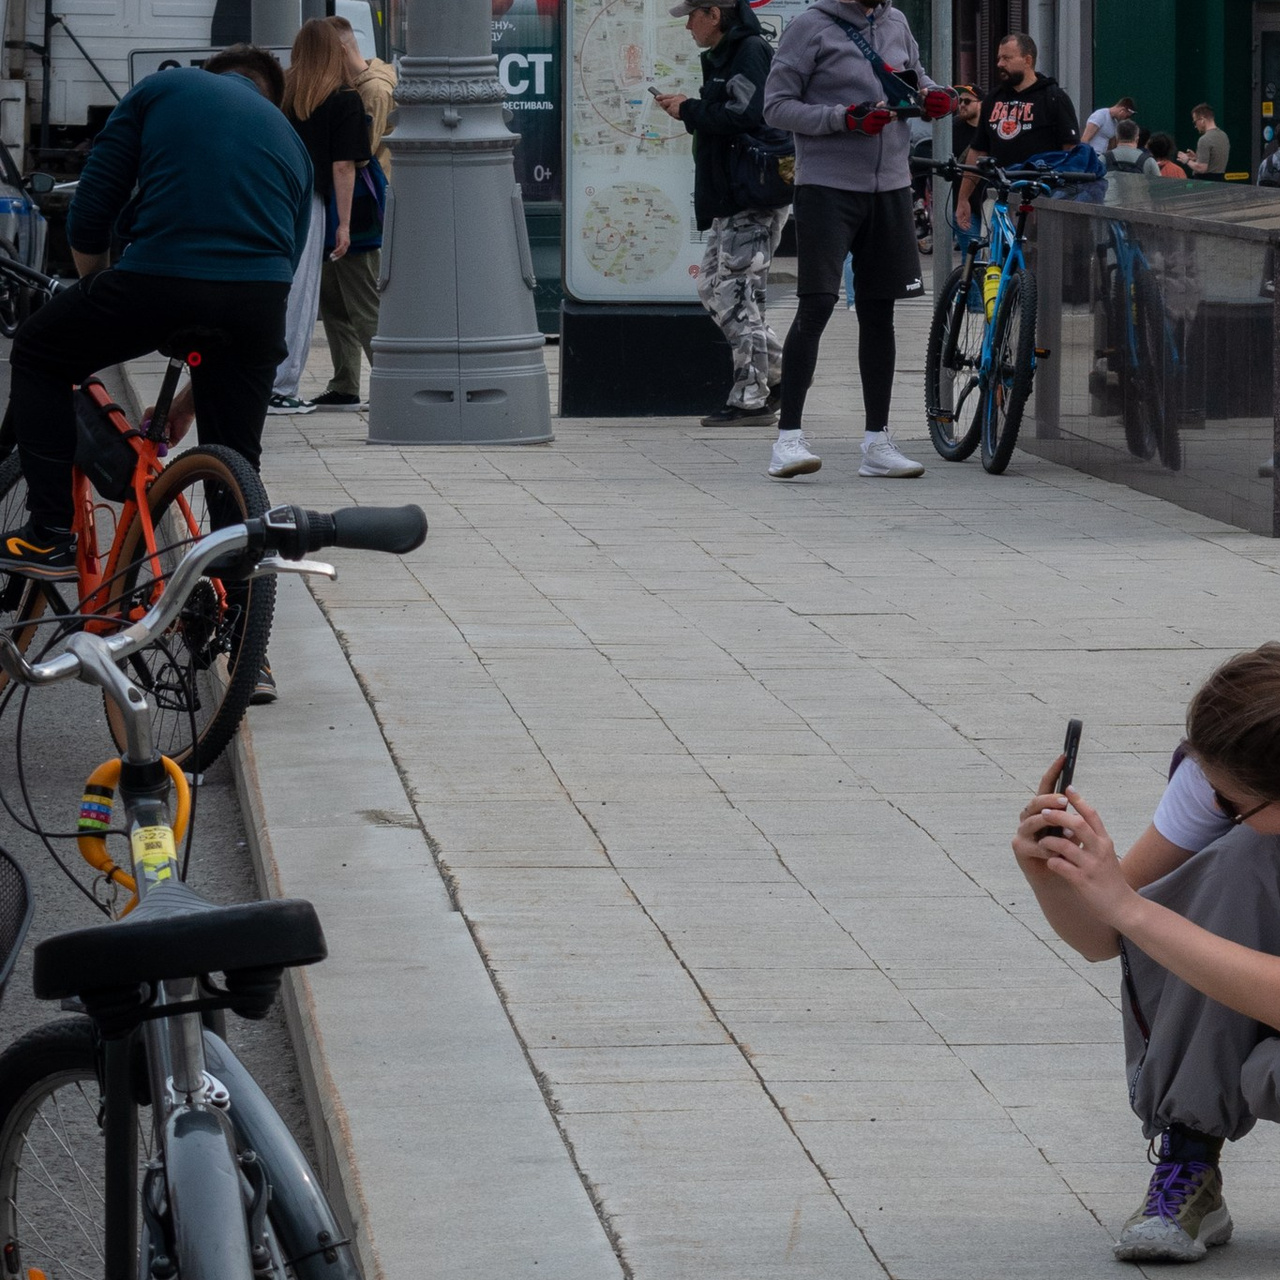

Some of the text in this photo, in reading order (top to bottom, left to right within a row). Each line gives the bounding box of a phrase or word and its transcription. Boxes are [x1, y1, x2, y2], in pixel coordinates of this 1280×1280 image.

[847, 26, 877, 61] TOMMY
[491, 53, 553, 95] СТ
[534, 164, 553, 182] 0+
